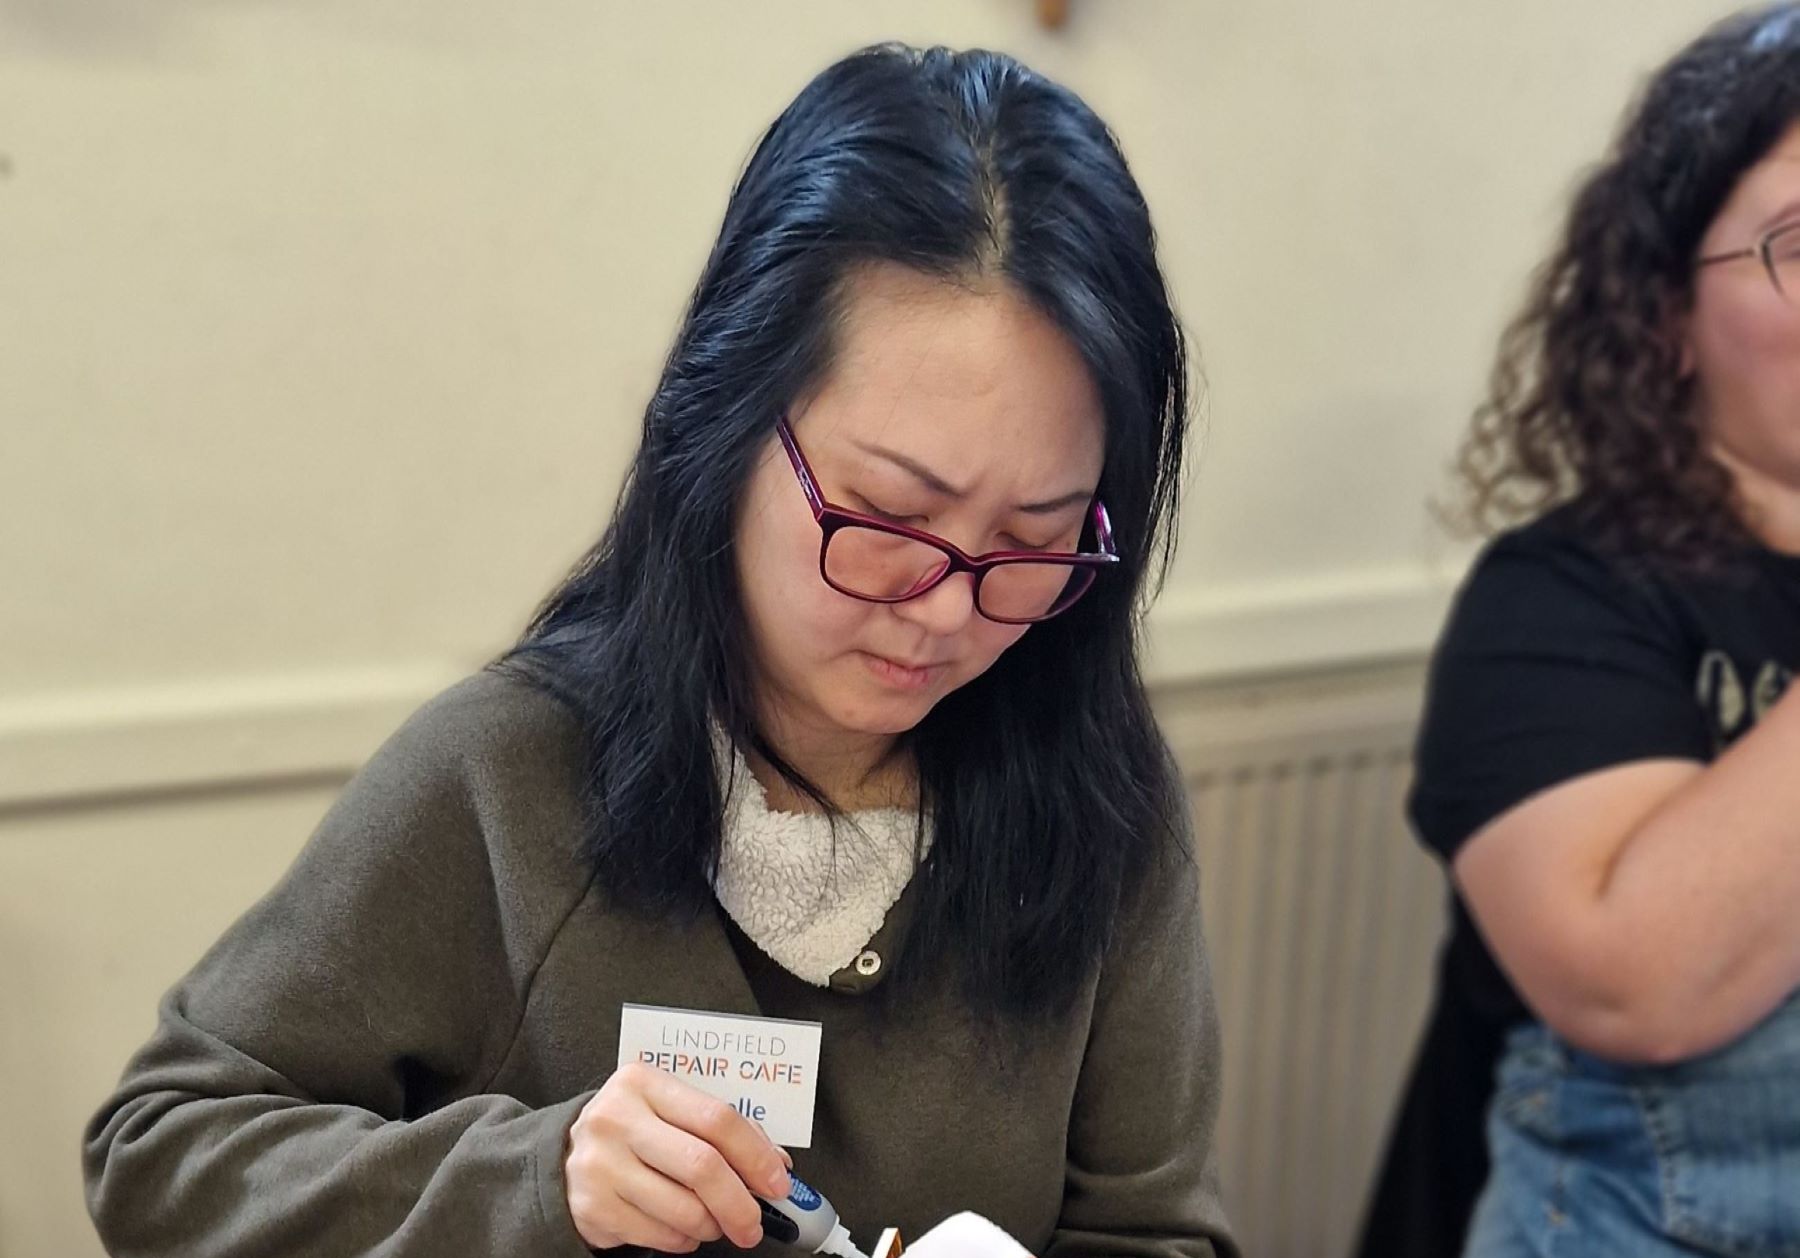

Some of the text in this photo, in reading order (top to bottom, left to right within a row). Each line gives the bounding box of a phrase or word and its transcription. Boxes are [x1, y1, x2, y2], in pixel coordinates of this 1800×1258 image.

[661, 1025, 787, 1057] LINDFIELD
[638, 1051, 804, 1085] REPAIR CAFE
